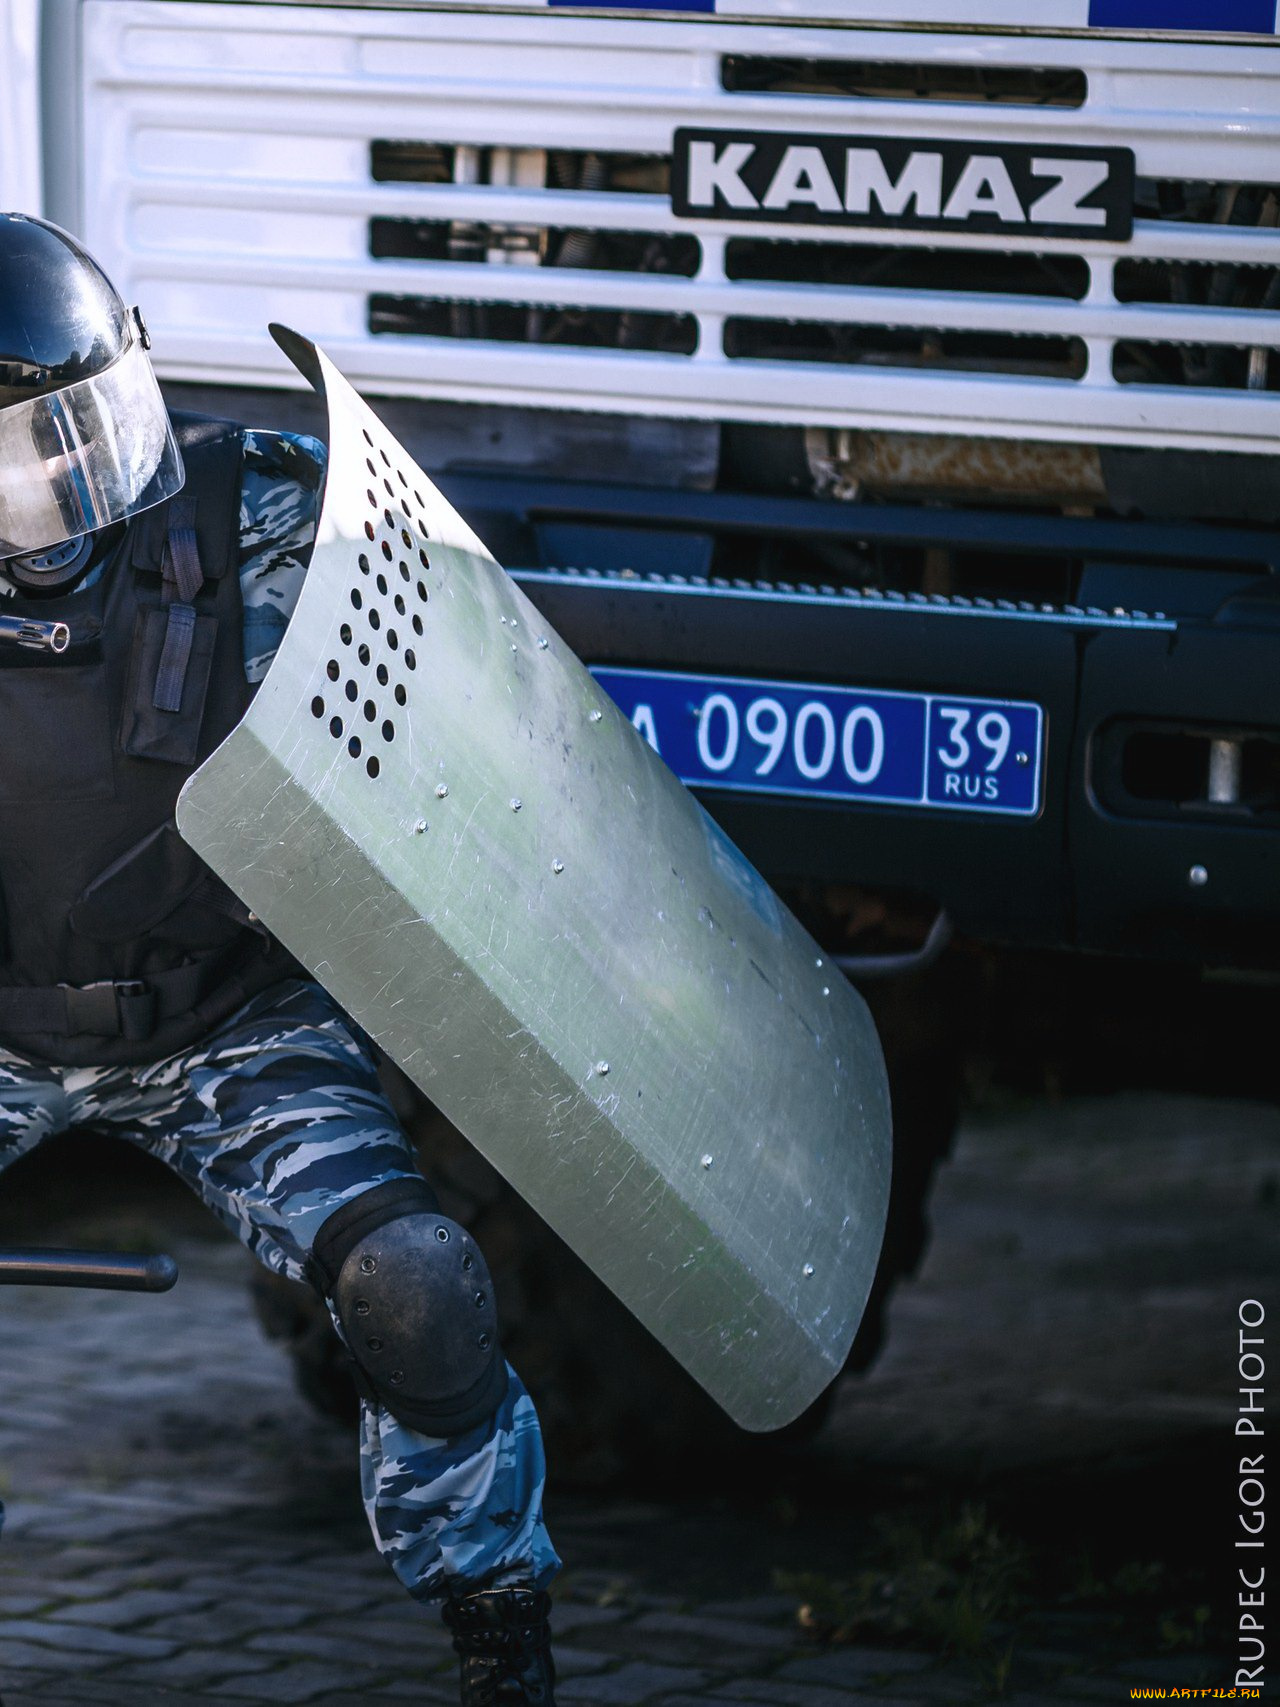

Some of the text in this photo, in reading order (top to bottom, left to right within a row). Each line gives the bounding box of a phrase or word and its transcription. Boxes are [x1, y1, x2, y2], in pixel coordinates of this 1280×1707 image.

[687, 140, 1109, 227] KAMAZ
[698, 694, 885, 784] 0900
[938, 707, 1011, 771] 39
[945, 773, 999, 799] RUS
